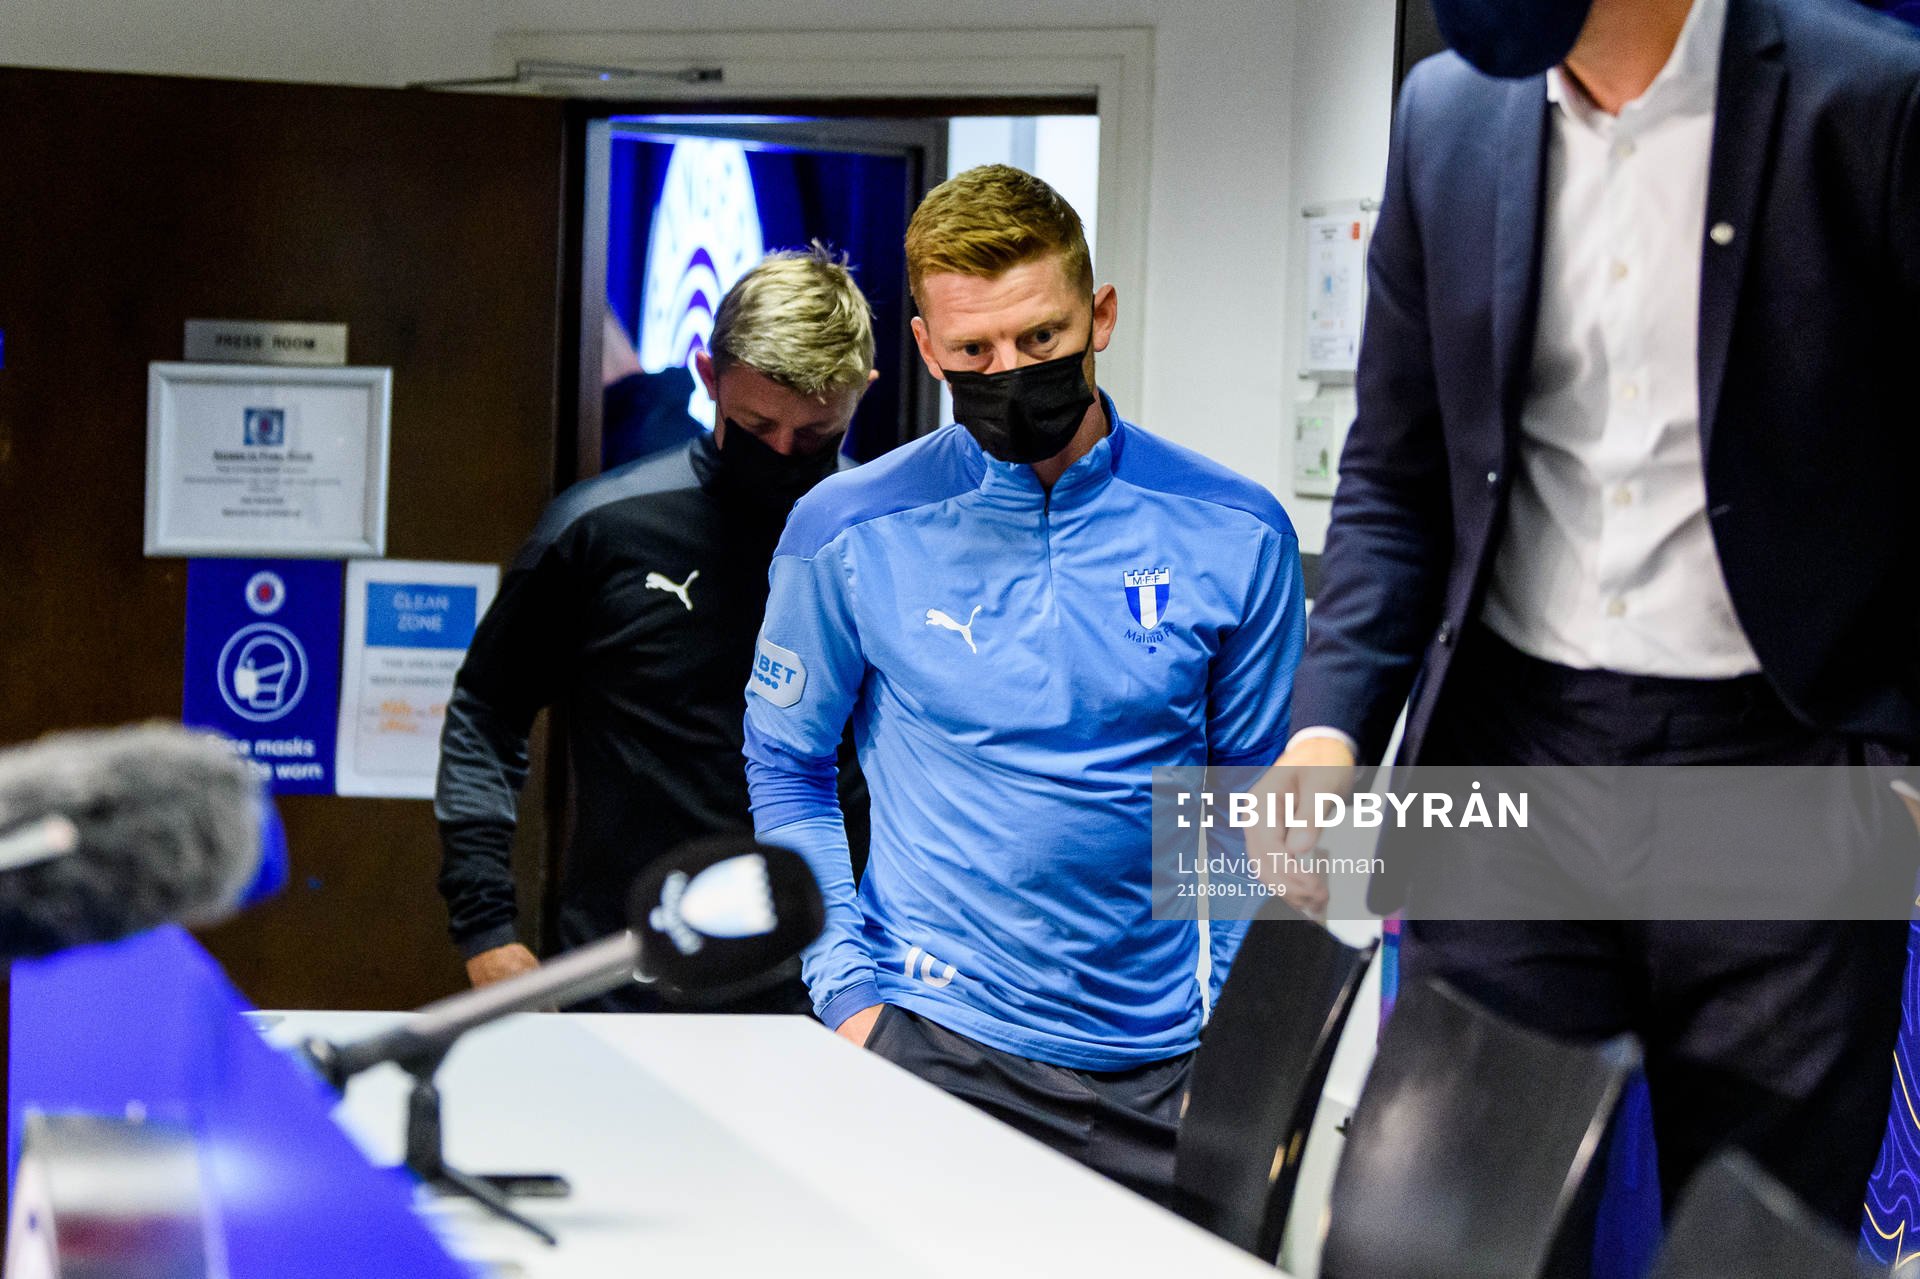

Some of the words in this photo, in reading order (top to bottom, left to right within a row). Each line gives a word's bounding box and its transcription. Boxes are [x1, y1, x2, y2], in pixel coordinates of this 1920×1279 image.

[215, 334, 262, 349] PRESS
[271, 335, 315, 350] ROOM
[393, 591, 448, 612] CLEAN
[397, 613, 442, 633] ZONE
[254, 736, 317, 758] masks
[275, 763, 324, 780] worn
